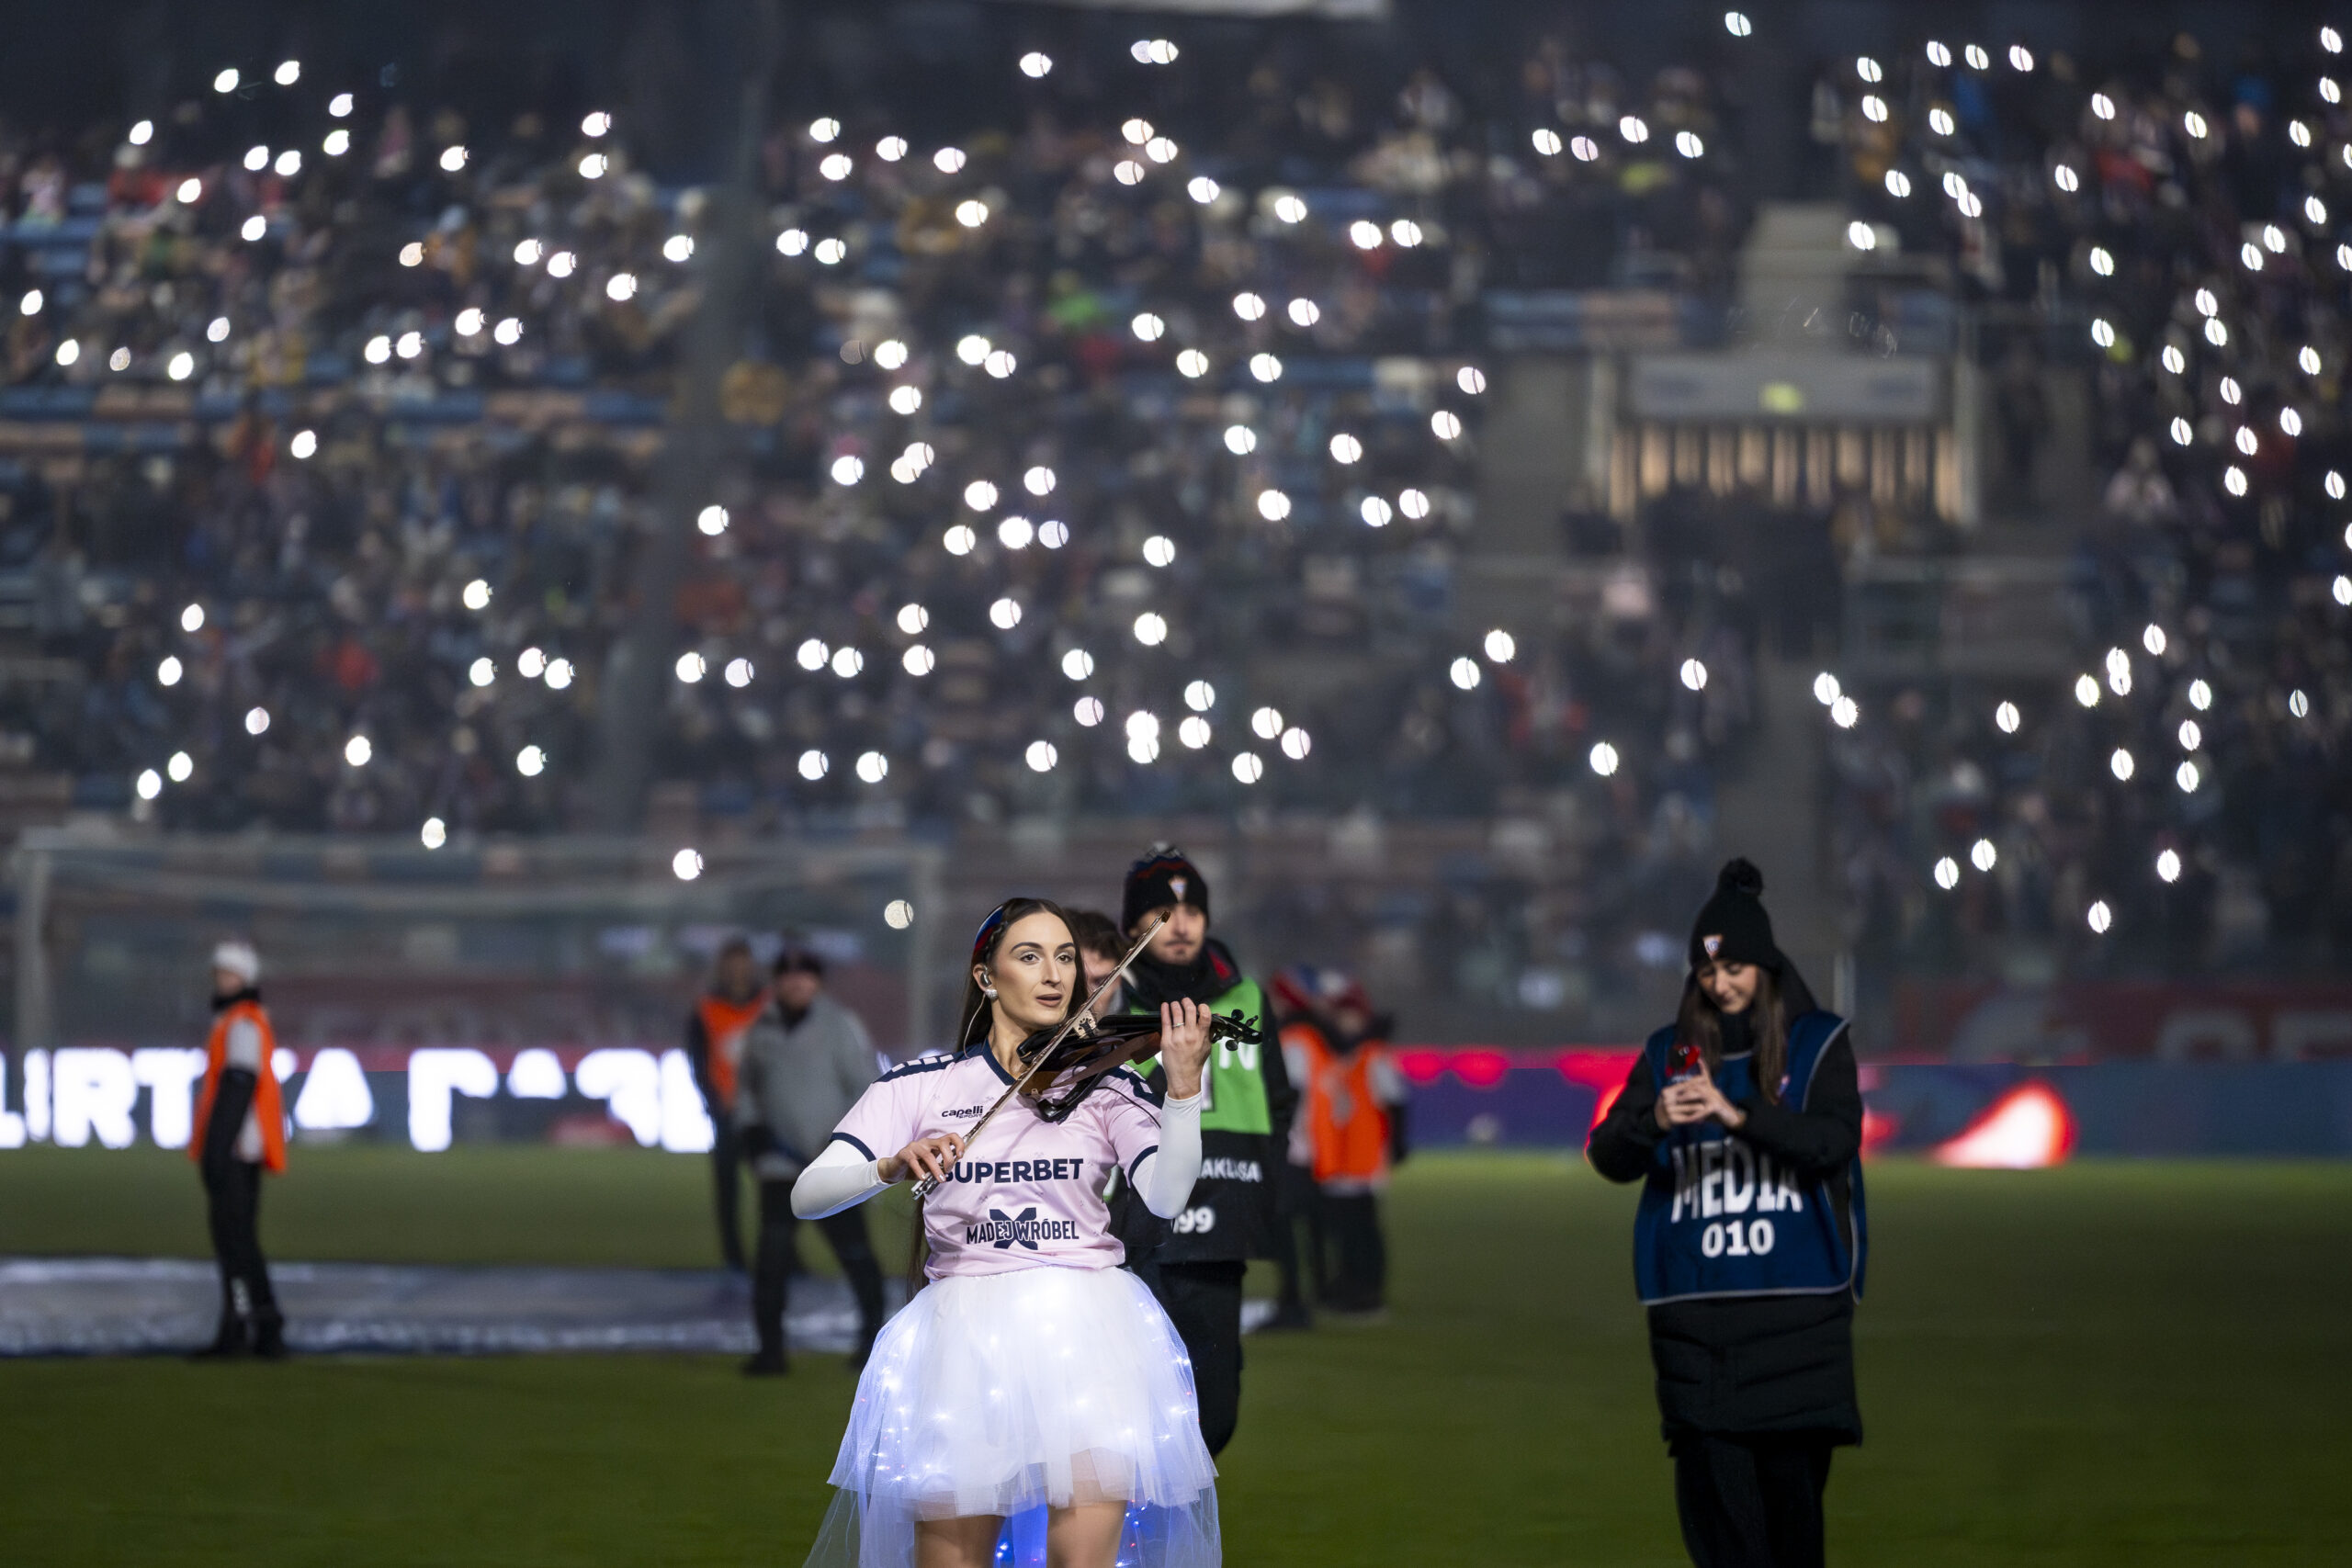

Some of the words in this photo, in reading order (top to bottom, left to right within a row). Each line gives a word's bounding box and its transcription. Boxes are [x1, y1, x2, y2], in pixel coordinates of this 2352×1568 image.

[941, 1105, 984, 1118] capelli
[1670, 1135, 1804, 1224] MEDIA
[966, 1221, 1013, 1245] MADEJ
[1014, 1218, 1080, 1242] WRÓBEL
[1701, 1218, 1775, 1258] 010
